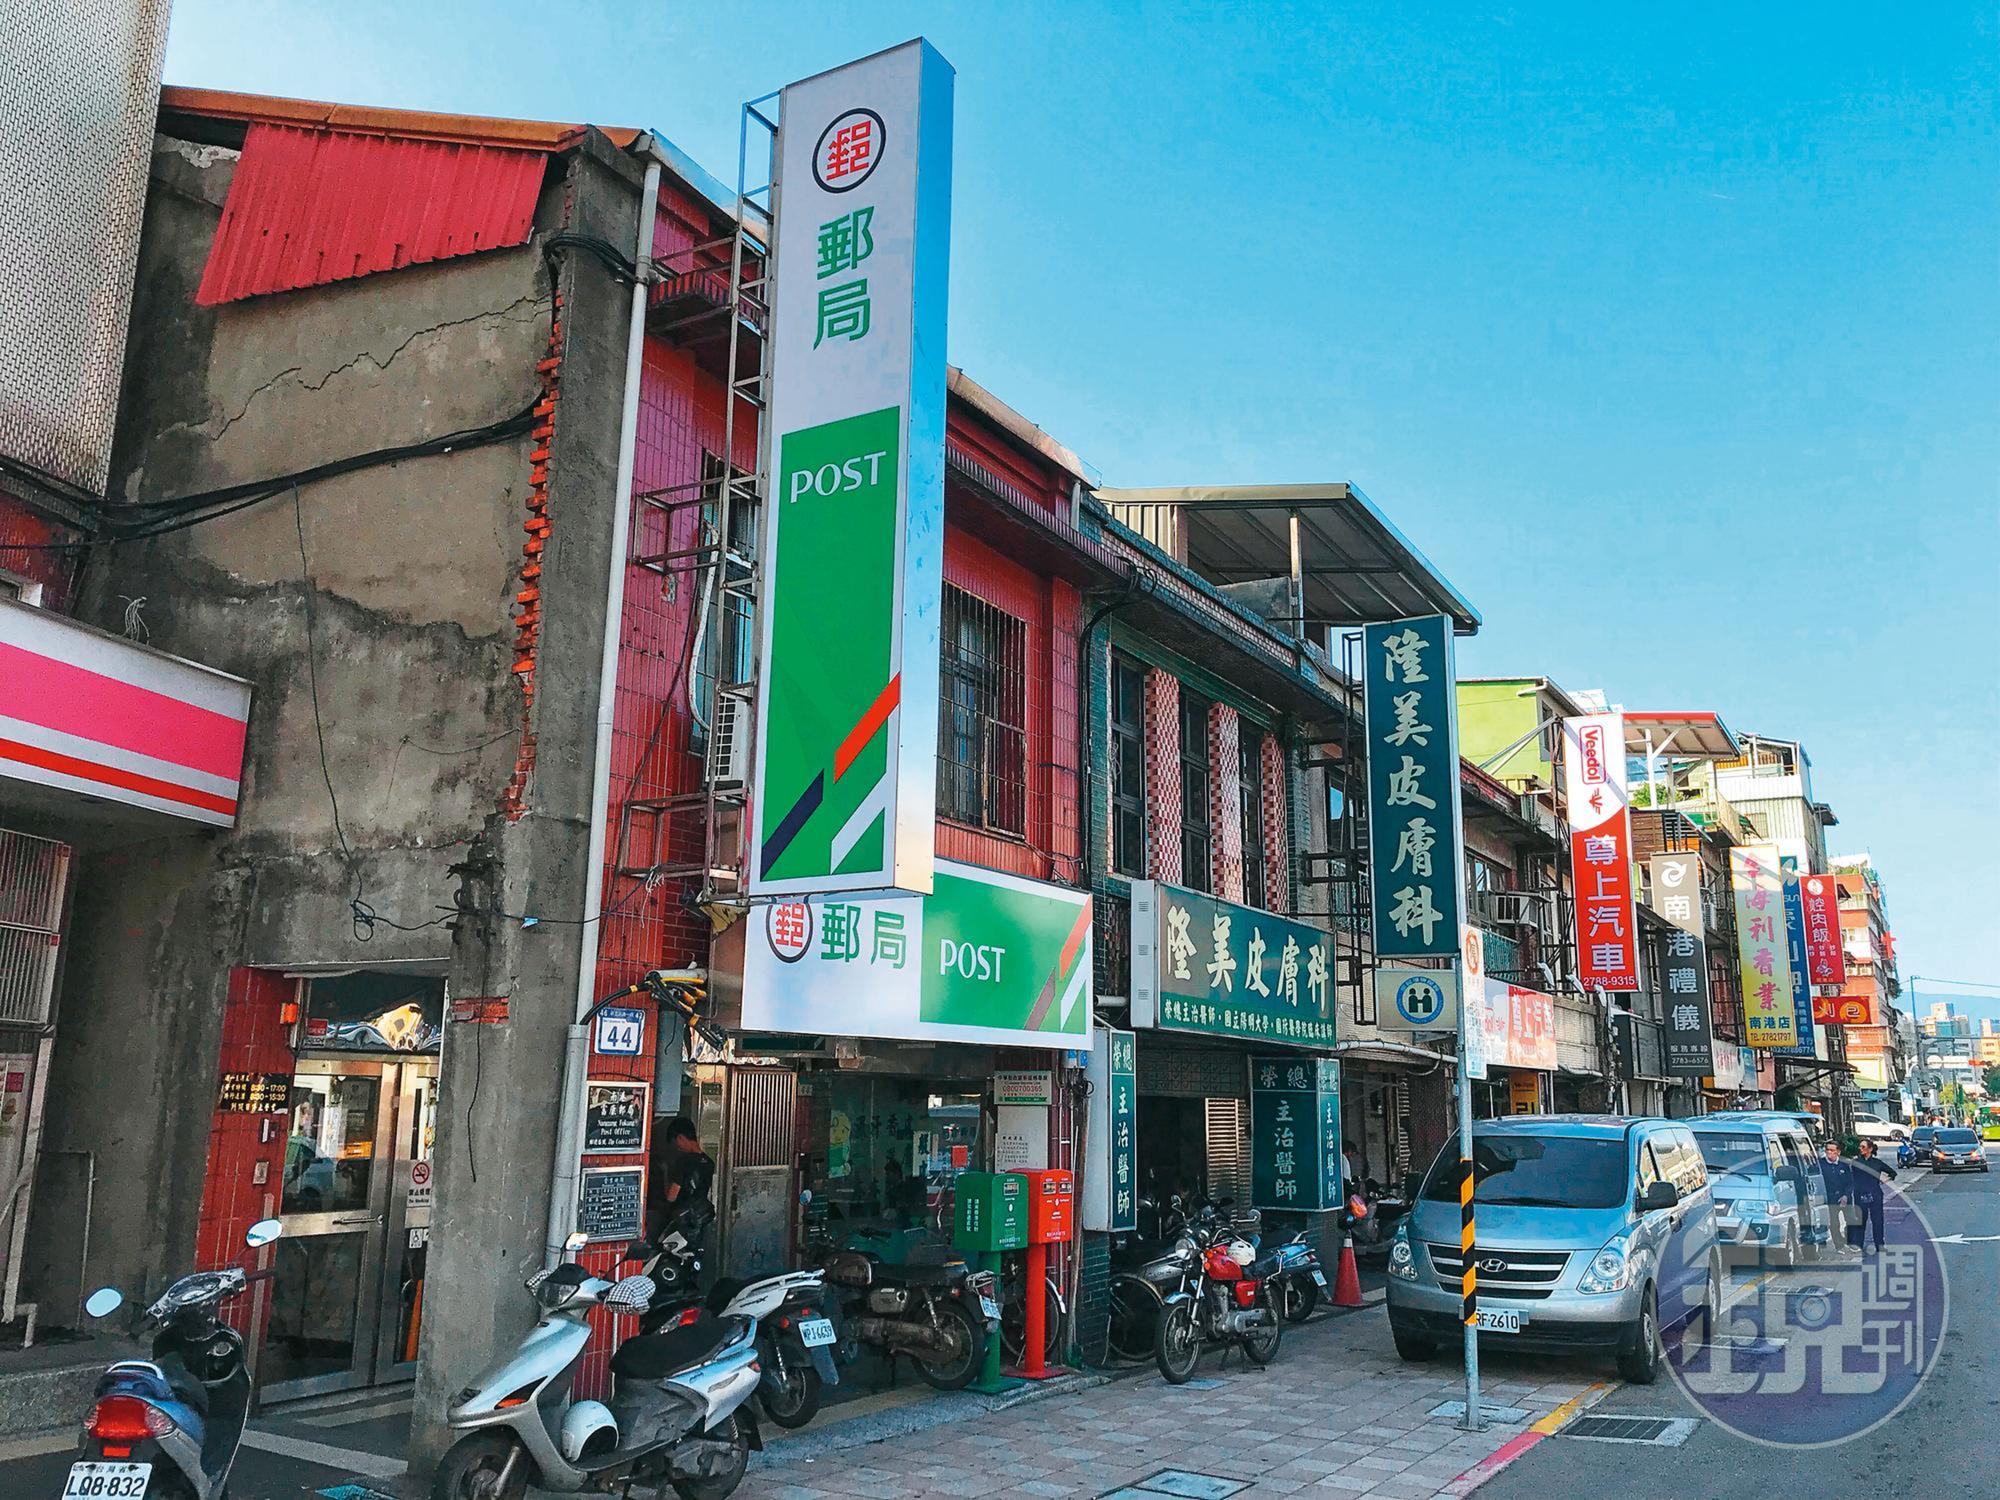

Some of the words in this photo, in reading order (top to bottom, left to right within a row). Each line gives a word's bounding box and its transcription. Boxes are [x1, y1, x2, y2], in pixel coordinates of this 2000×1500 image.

[813, 205, 875, 350] 郵局
[789, 451, 887, 503] POST
[1381, 628, 1444, 947] 隆美皮膚科
[1583, 729, 1602, 781] Veedol
[820, 902, 907, 969] 郵局
[1584, 834, 1626, 974] 尊上汽車
[940, 938, 1006, 983] POST
[1166, 905, 1329, 1012] 隆美皮膚科
[1663, 894, 1701, 1033] 南港禮儀
[607, 1025, 632, 1048] 44
[1113, 1041, 1133, 1072] 榮總
[1748, 1016, 1791, 1030] 南港店
[1260, 1064, 1308, 1090] 榮總
[1116, 1086, 1130, 1218] 主治醫師
[1273, 1099, 1297, 1201] 主治醫師
[1325, 1102, 1337, 1201] 主治醫師
